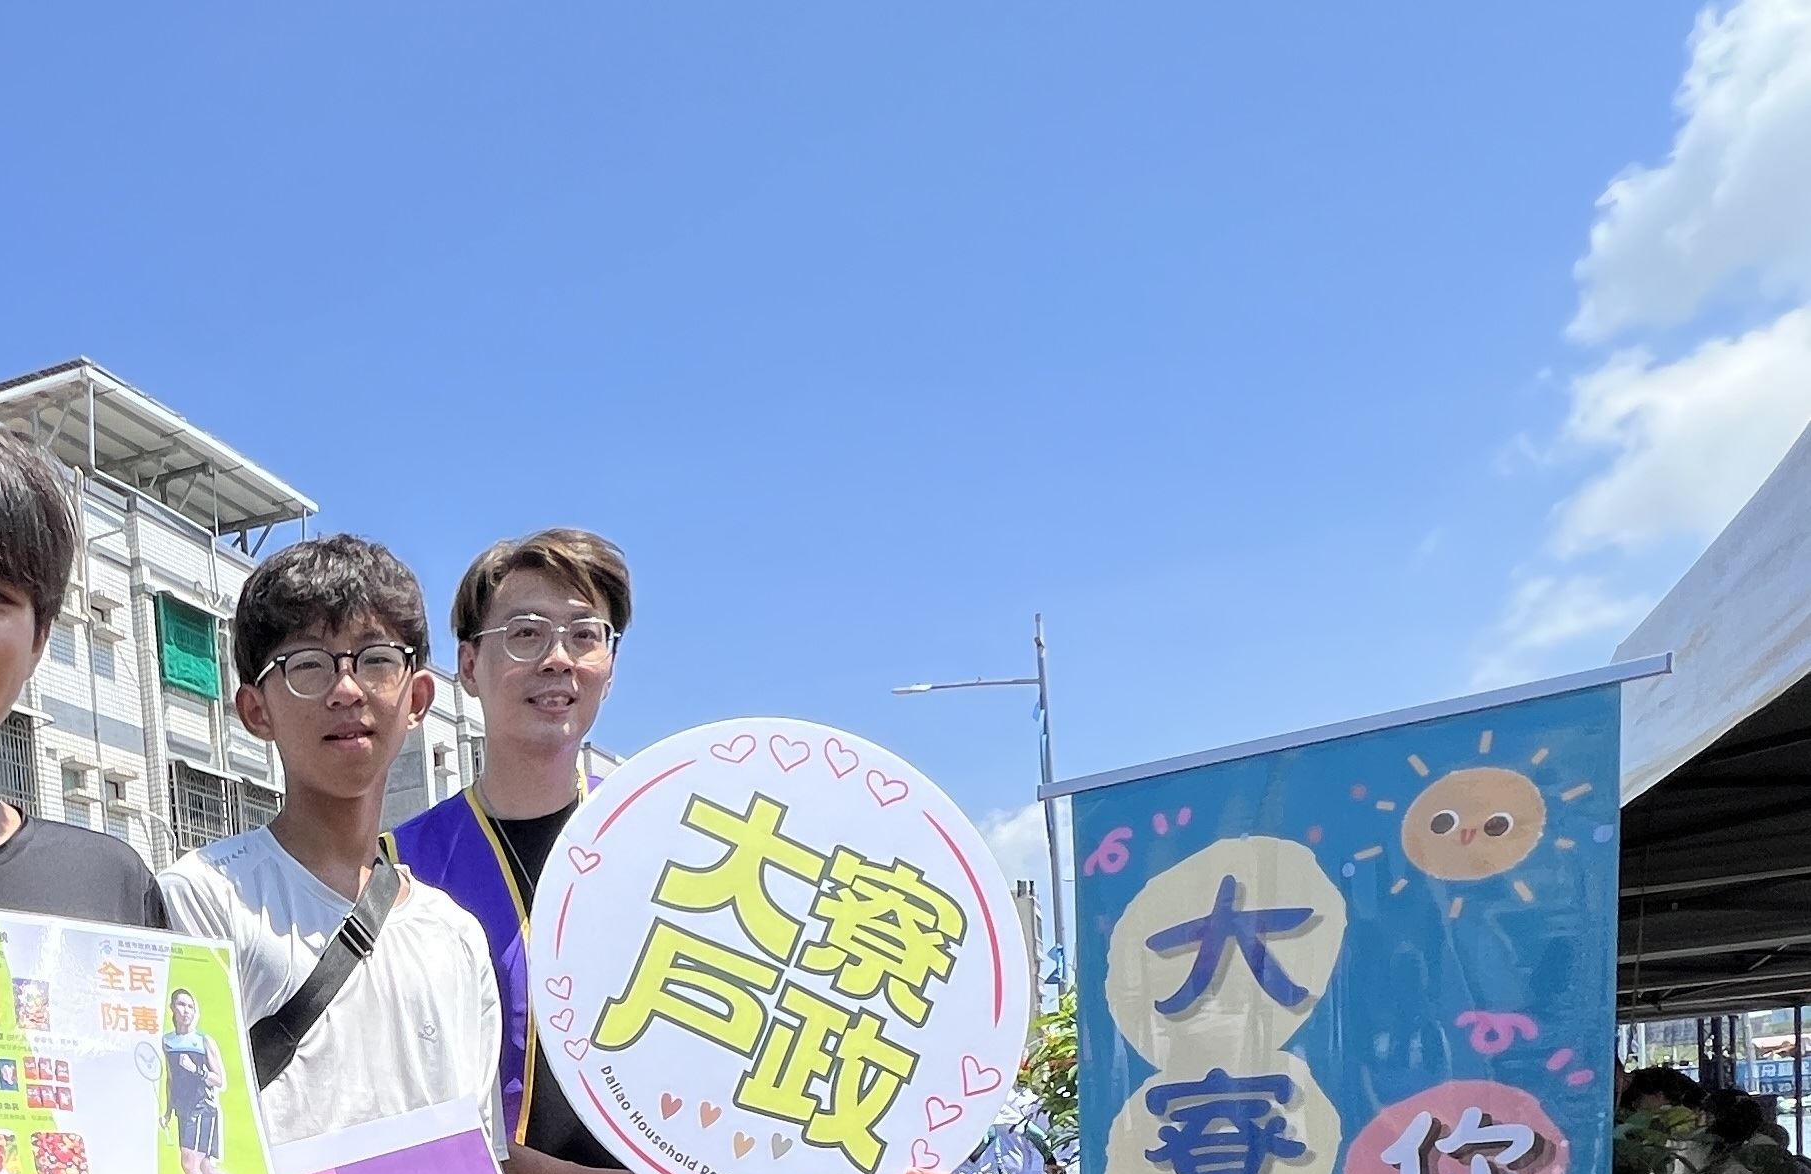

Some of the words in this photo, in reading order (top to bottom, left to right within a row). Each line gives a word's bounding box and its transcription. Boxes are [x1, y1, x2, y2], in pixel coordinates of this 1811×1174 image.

[651, 791, 967, 1028] 大寮
[97, 960, 156, 994] 全民
[100, 1001, 160, 1035] 防毒
[600, 1065, 631, 1111] Daliao
[629, 1111, 698, 1171] Household
